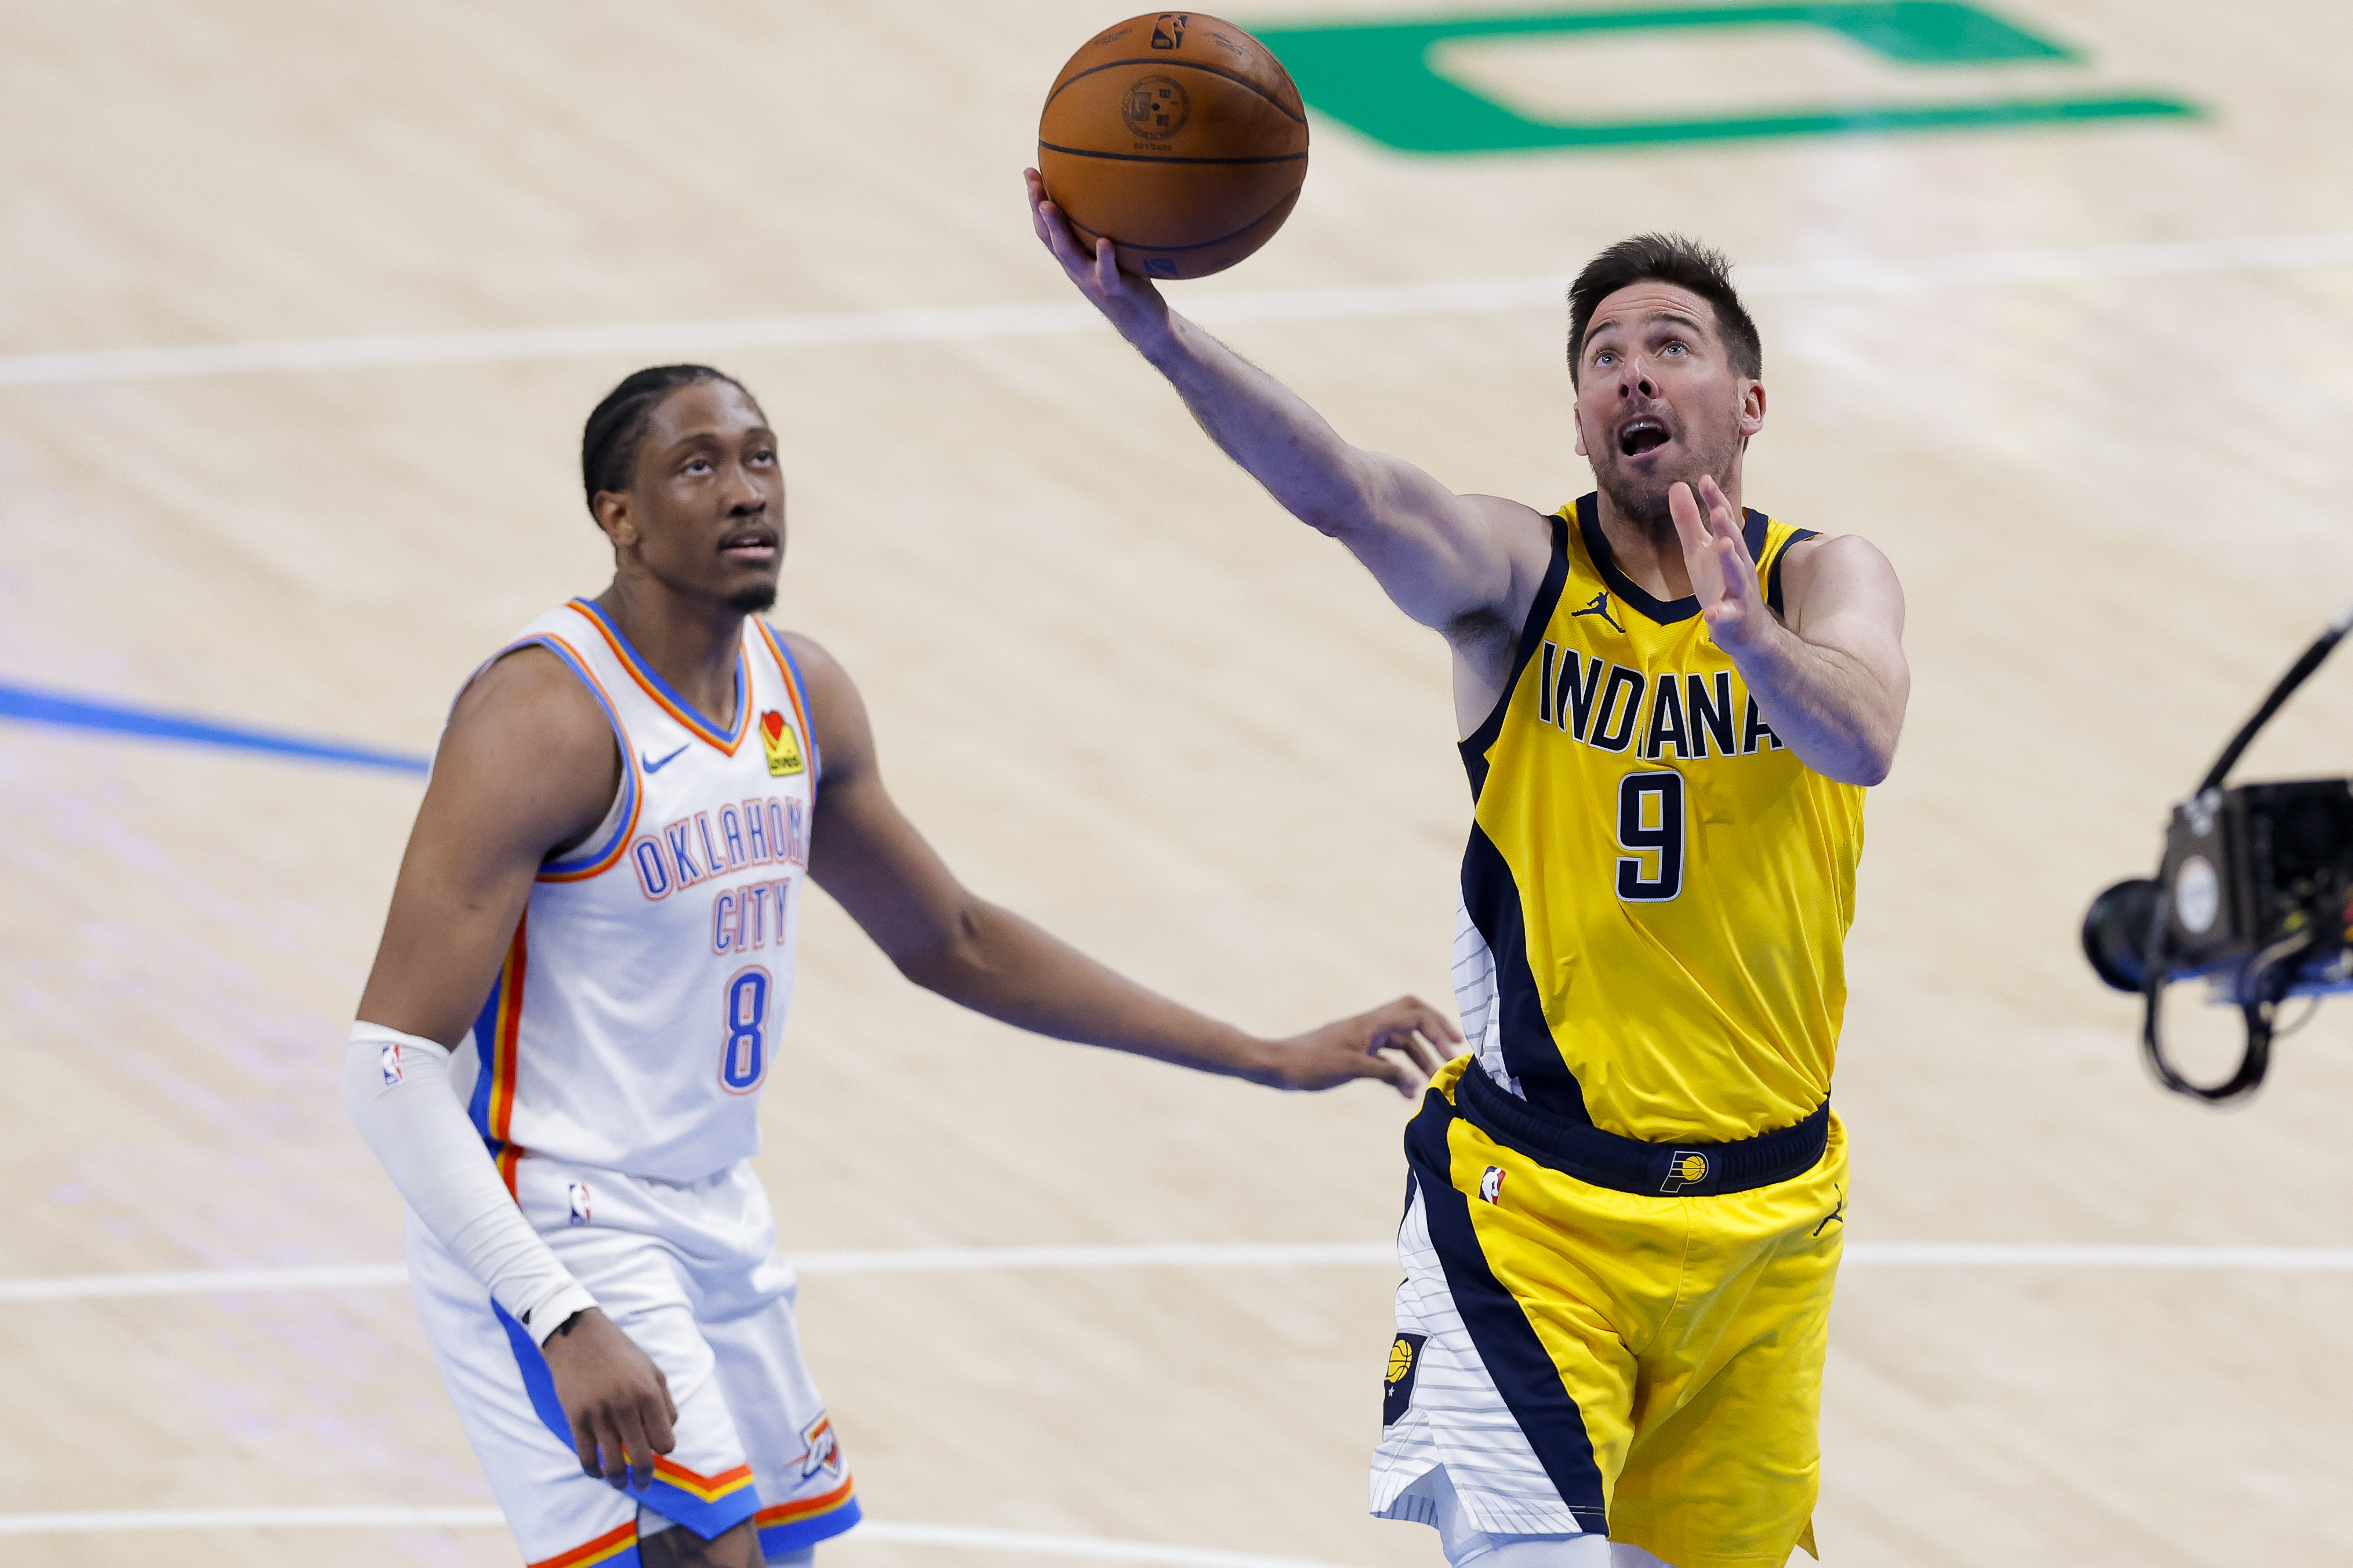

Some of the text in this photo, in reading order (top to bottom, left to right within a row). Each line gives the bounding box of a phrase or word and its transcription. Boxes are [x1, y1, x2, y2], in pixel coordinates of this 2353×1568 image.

[1539, 639, 1785, 761] INDANA
[630, 796, 806, 900] OKLAHOM
[1616, 770, 1685, 902] 9
[711, 878, 790, 955] CITY
[718, 965, 772, 1096] 8
